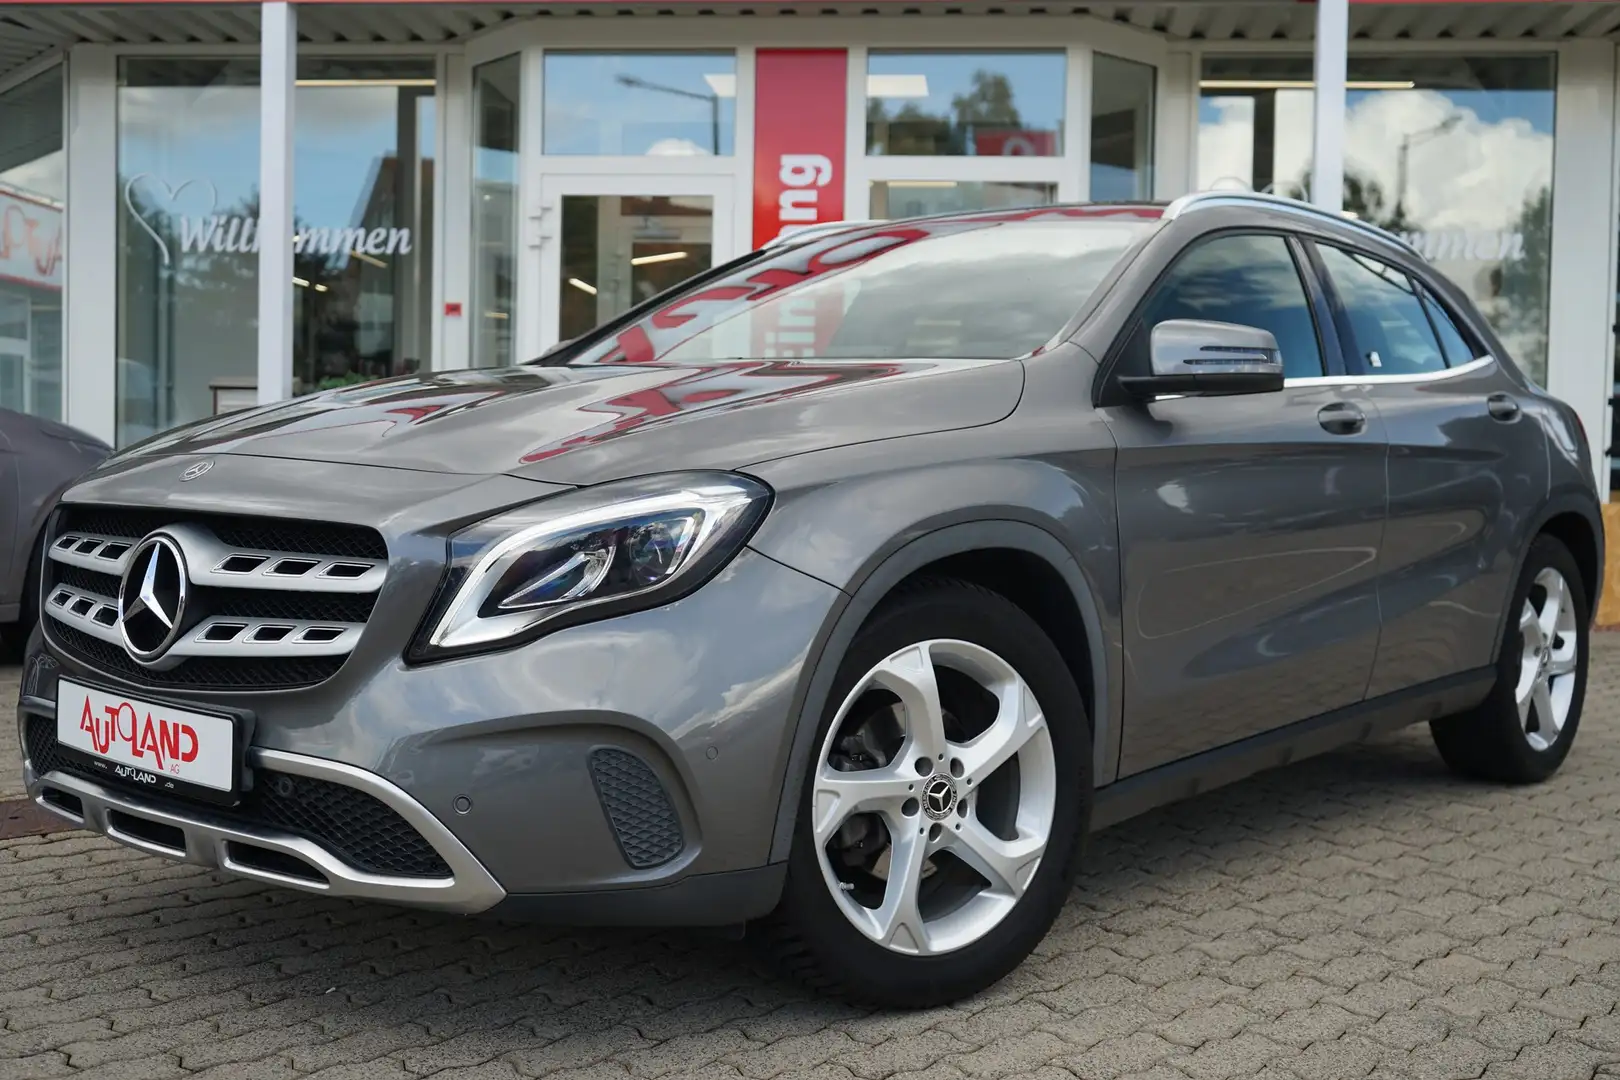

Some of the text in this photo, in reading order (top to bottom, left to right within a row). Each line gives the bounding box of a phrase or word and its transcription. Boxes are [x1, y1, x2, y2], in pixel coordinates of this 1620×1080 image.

[180, 215, 412, 256] Willmmen
[80, 695, 198, 770] AUTOLAND
[115, 765, 157, 783] AUTOLAND
[170, 763, 180, 774] AG
